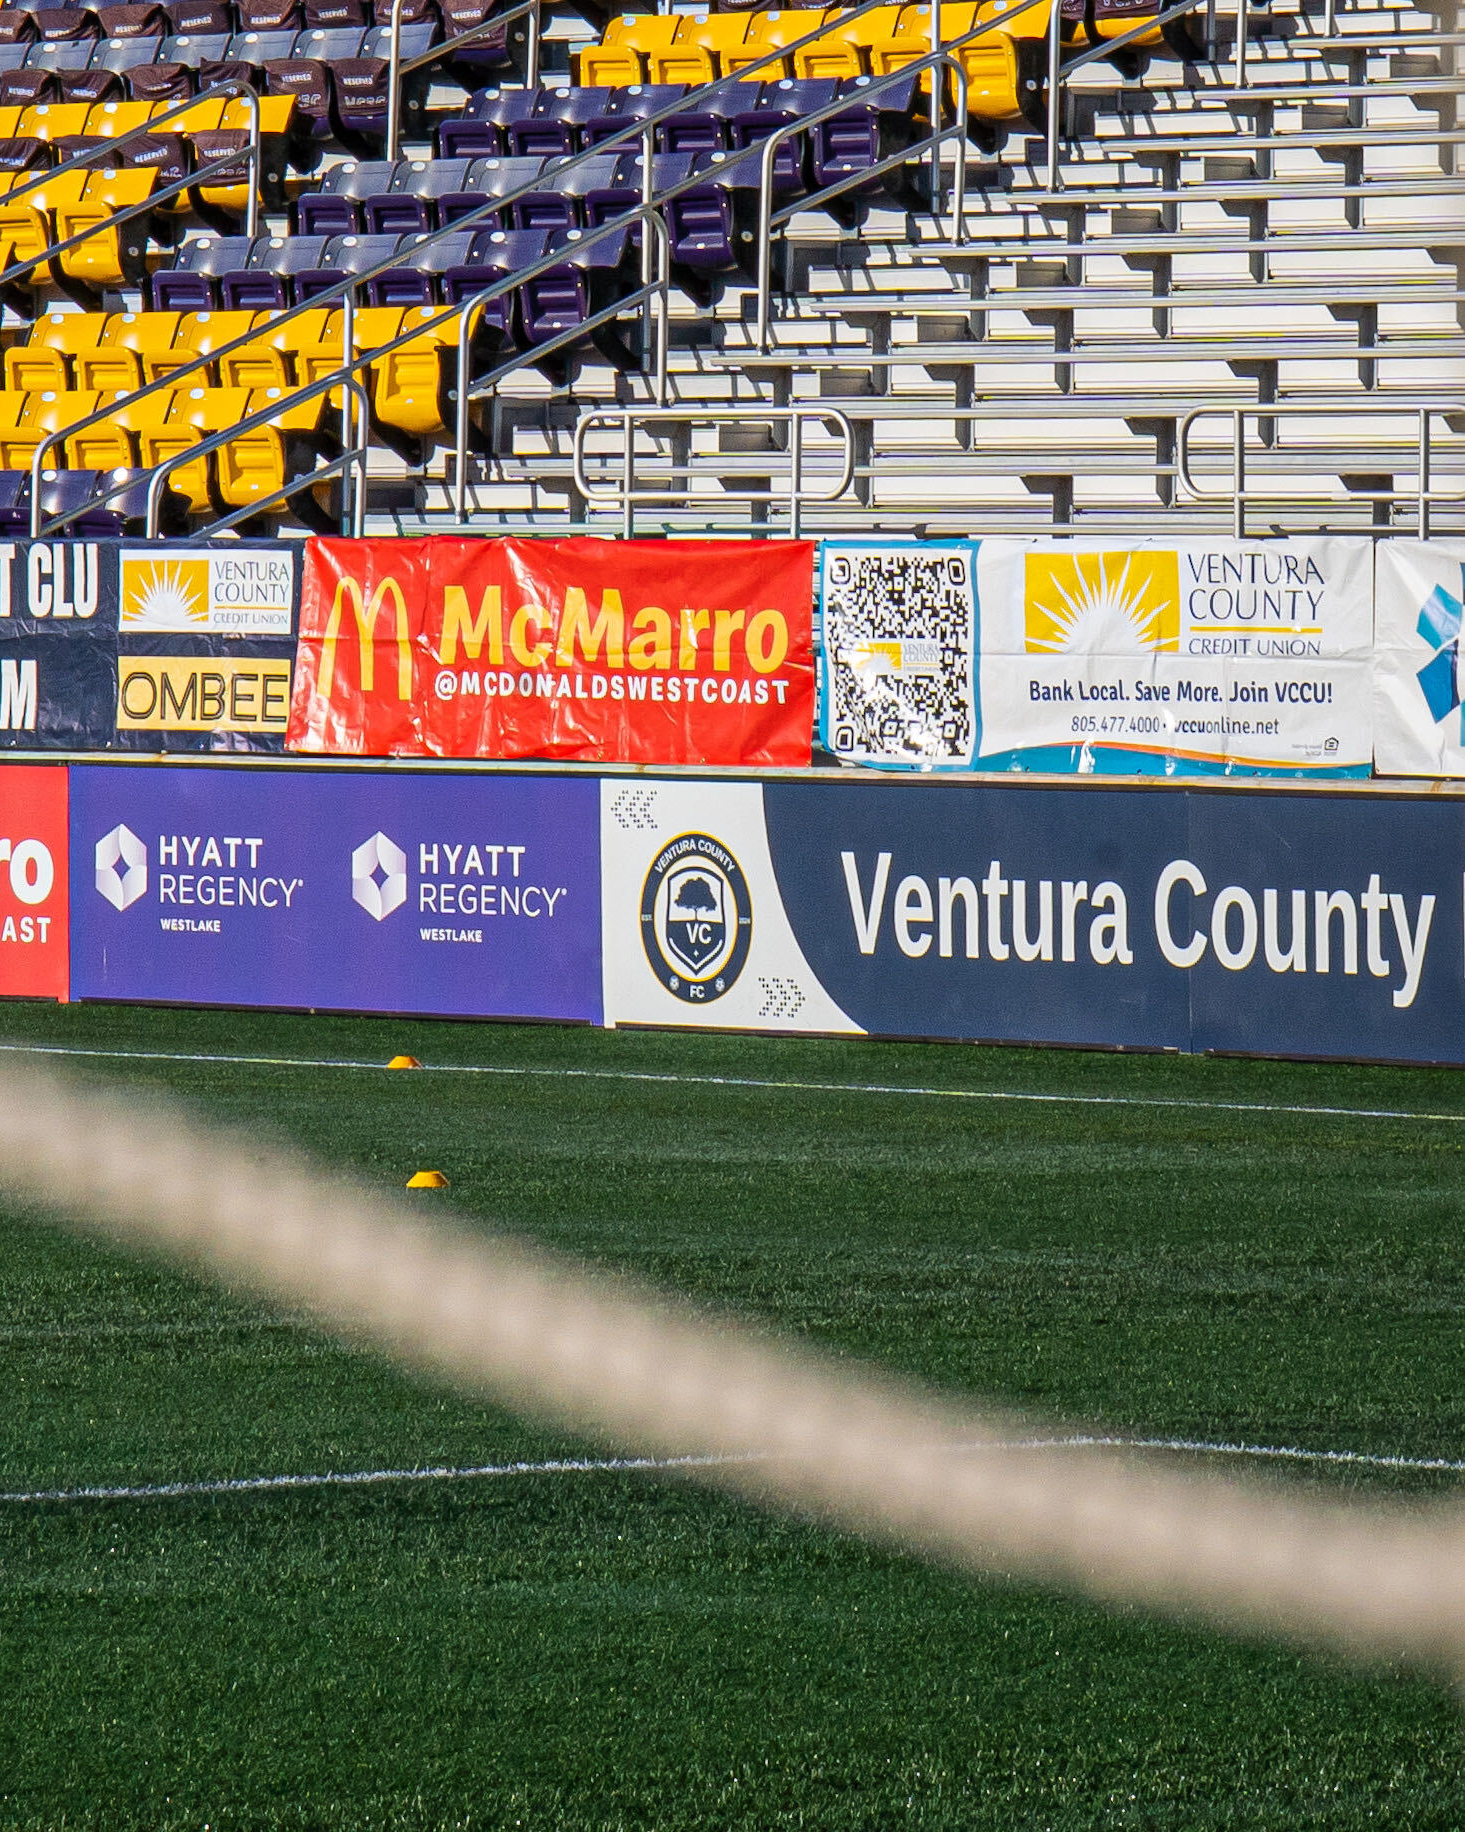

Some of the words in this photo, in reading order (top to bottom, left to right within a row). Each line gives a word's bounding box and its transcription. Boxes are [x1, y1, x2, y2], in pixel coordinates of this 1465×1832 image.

[251, 15, 282, 25] RESERVED
[282, 72, 312, 83] RESERVED
[342, 75, 374, 86] RESERVED
[134, 147, 169, 164] RESERVED
[204, 147, 236, 158] RESERVED
[215, 561, 290, 581] VENTURA
[1188, 553, 1325, 585] VENTURA
[27, 543, 99, 618] CLU
[215, 582, 290, 603] COUNTY
[1188, 588, 1325, 621] COUNTY
[213, 612, 249, 625] CREDIT
[252, 613, 288, 626] UNION
[440, 584, 790, 675] McMarro
[1188, 638, 1251, 655] CREDIT
[1257, 640, 1321, 657] UNION
[121, 672, 288, 724] OMBEE
[434, 669, 790, 706] @MCDONALDSWESTCOAST
[1029, 680, 1074, 701] Bank
[1079, 680, 1130, 702] Local.
[1135, 681, 1170, 701] Save
[1177, 681, 1223, 702] More.
[1229, 682, 1269, 704] Join
[1275, 682, 1333, 704] VCCU!
[1071, 716, 1160, 734] 805.477.4000
[160, 835, 263, 869] HYATT
[419, 843, 526, 877] HYATT
[654, 839, 696, 874] VENTURA
[697, 840, 736, 873] COUNTY
[160, 918, 221, 933] WESTLAKE
[420, 928, 483, 943] WESTLAKE
[686, 922, 712, 945] VC
[841, 851, 1134, 964] Ventura
[1154, 859, 1436, 1008] County
[689, 984, 706, 999] FC
